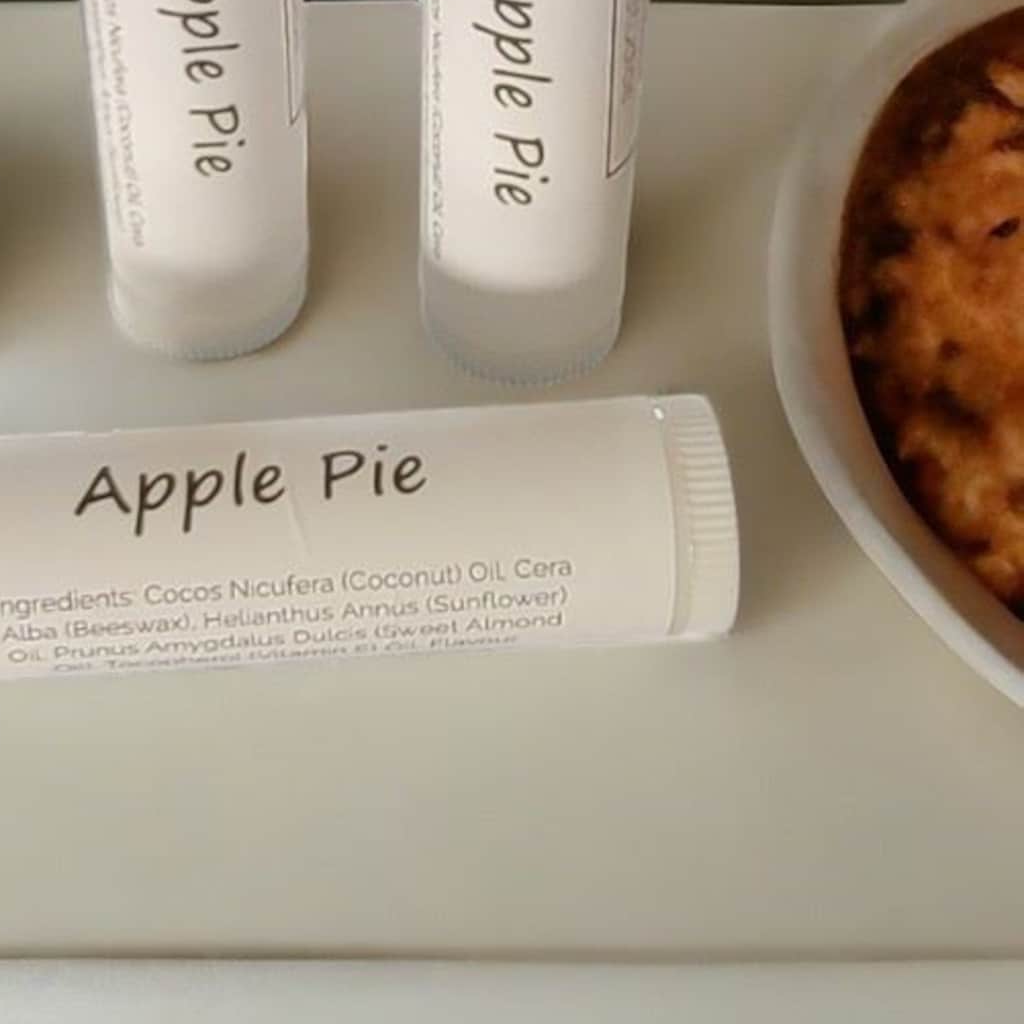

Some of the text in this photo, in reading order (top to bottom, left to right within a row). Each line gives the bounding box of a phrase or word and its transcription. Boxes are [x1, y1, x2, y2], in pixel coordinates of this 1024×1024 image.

[188, 103, 246, 177] Pie
[493, 132, 550, 206] Pie
[73, 444, 427, 538] Apple Pie
[144, 583, 223, 606] Cocos
[229, 574, 335, 601] Nicufera
[341, 564, 463, 593] (Coconut)
[513, 557, 573, 579] Cera
[2, 623, 58, 643] Alba
[204, 604, 335, 630] Helianthus
[341, 599, 420, 620] Annus
[425, 586, 569, 614] (Sunflower)
[53, 643, 140, 660] Prunus
[144, 631, 286, 654] Amygdalus
[292, 626, 368, 645] Dulcis
[464, 611, 563, 633] Almond
